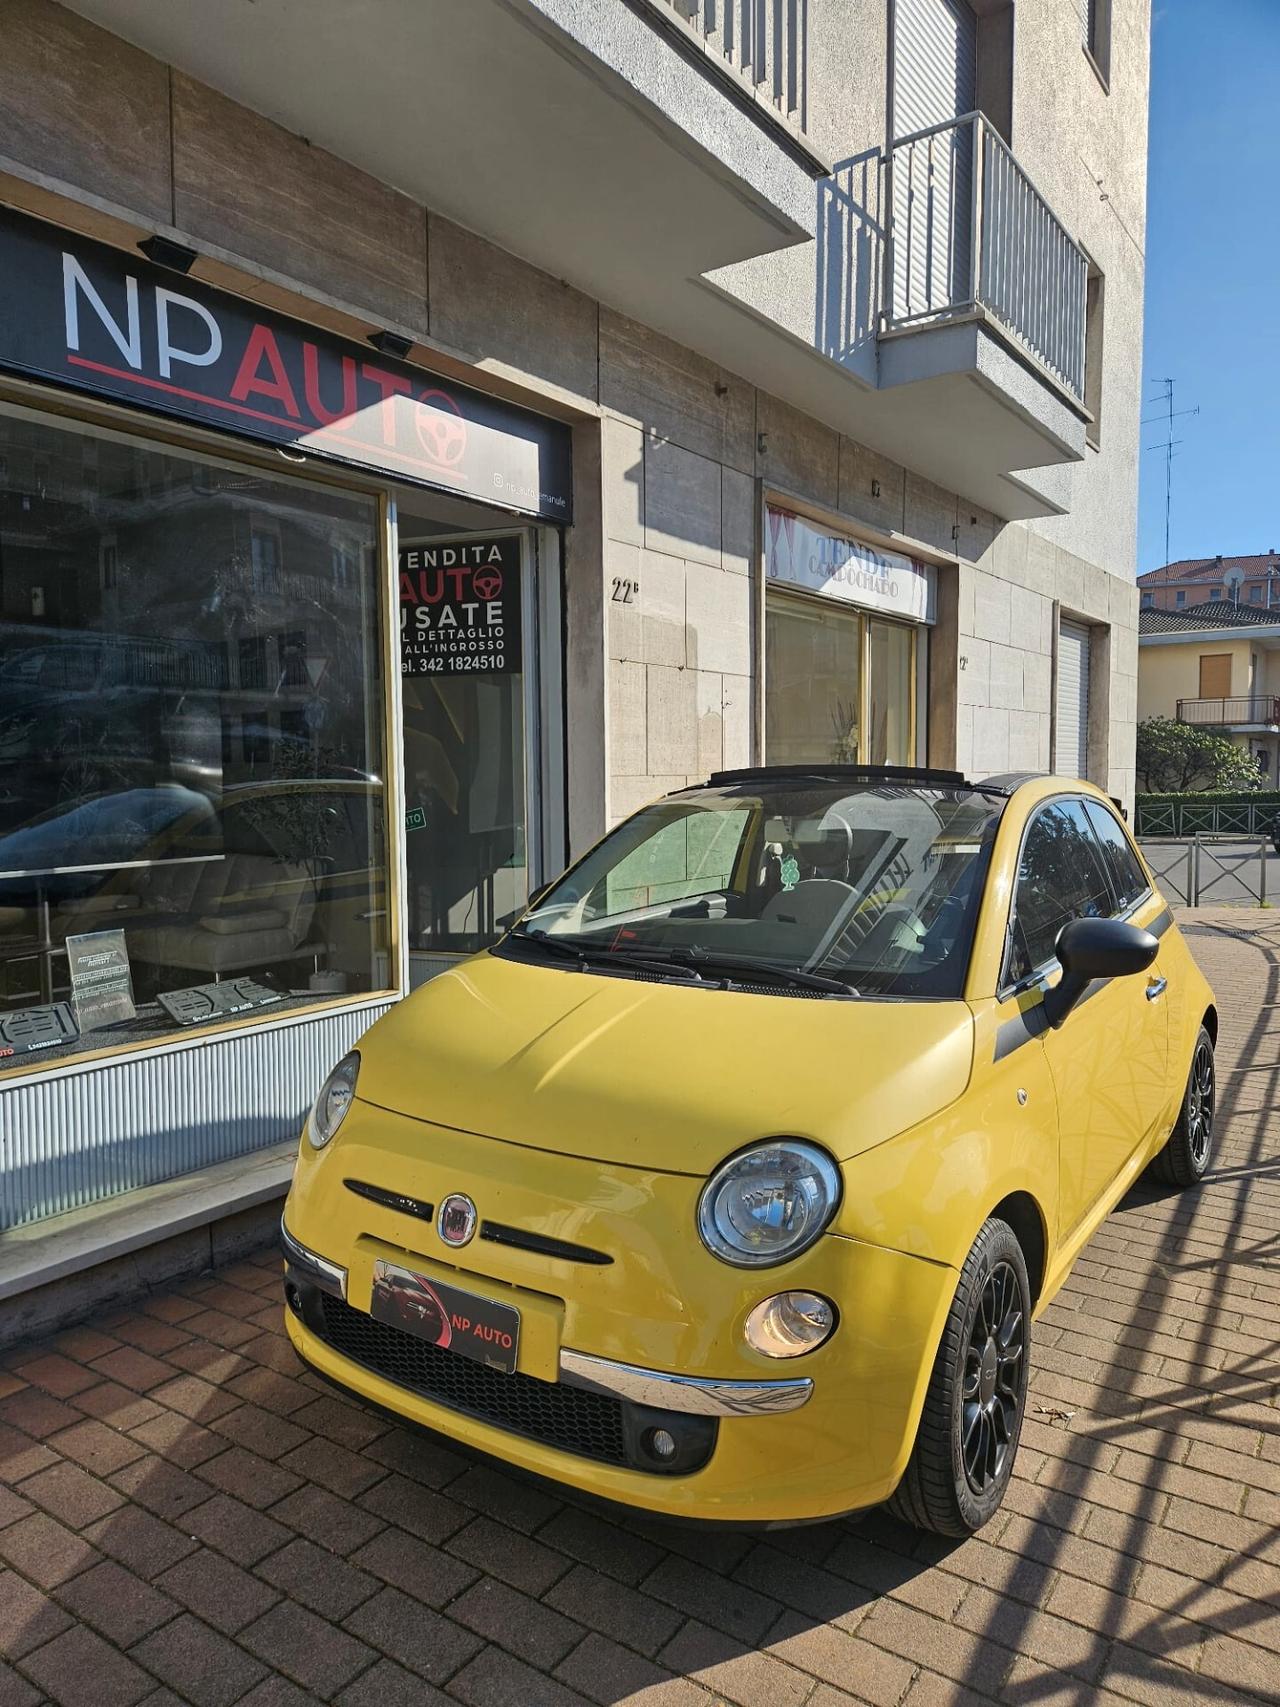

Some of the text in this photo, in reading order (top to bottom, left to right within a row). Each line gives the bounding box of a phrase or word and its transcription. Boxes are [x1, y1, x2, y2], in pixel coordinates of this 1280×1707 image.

[815, 535, 893, 578] TENDE
[417, 626, 505, 641] DETTAGLIO
[405, 640, 505, 655] ALL'INGROSSO
[401, 653, 505, 673] el. 342 1824510
[0, 1047, 14, 1057] UTO
[451, 1314, 513, 1349] NP AUTO
